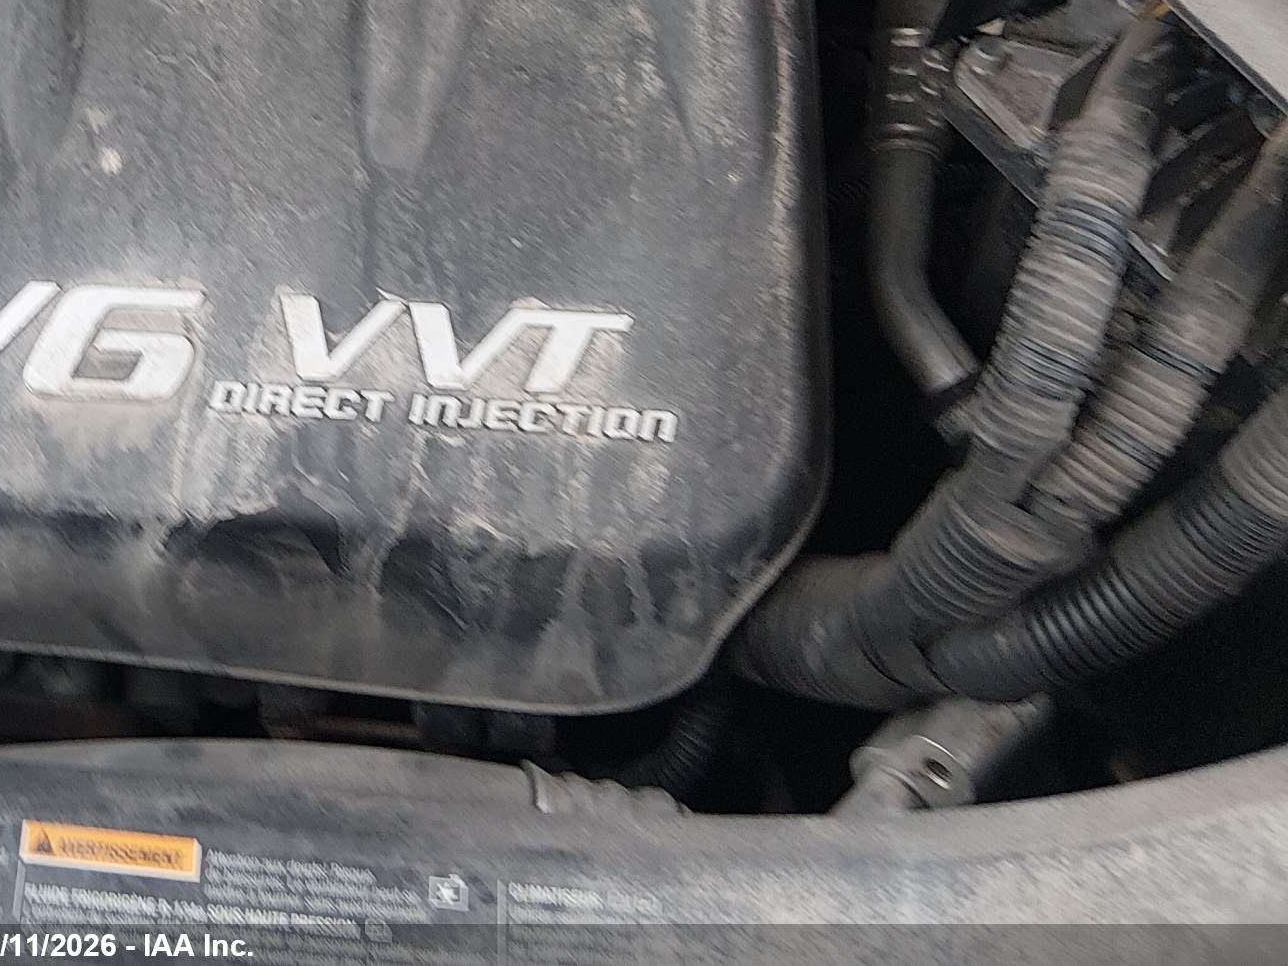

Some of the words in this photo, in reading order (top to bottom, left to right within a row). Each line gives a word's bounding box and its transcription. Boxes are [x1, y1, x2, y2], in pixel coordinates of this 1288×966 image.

[280, 290, 635, 395] VVT
[210, 379, 395, 423] DIRECT
[409, 393, 680, 443] INJECTION
